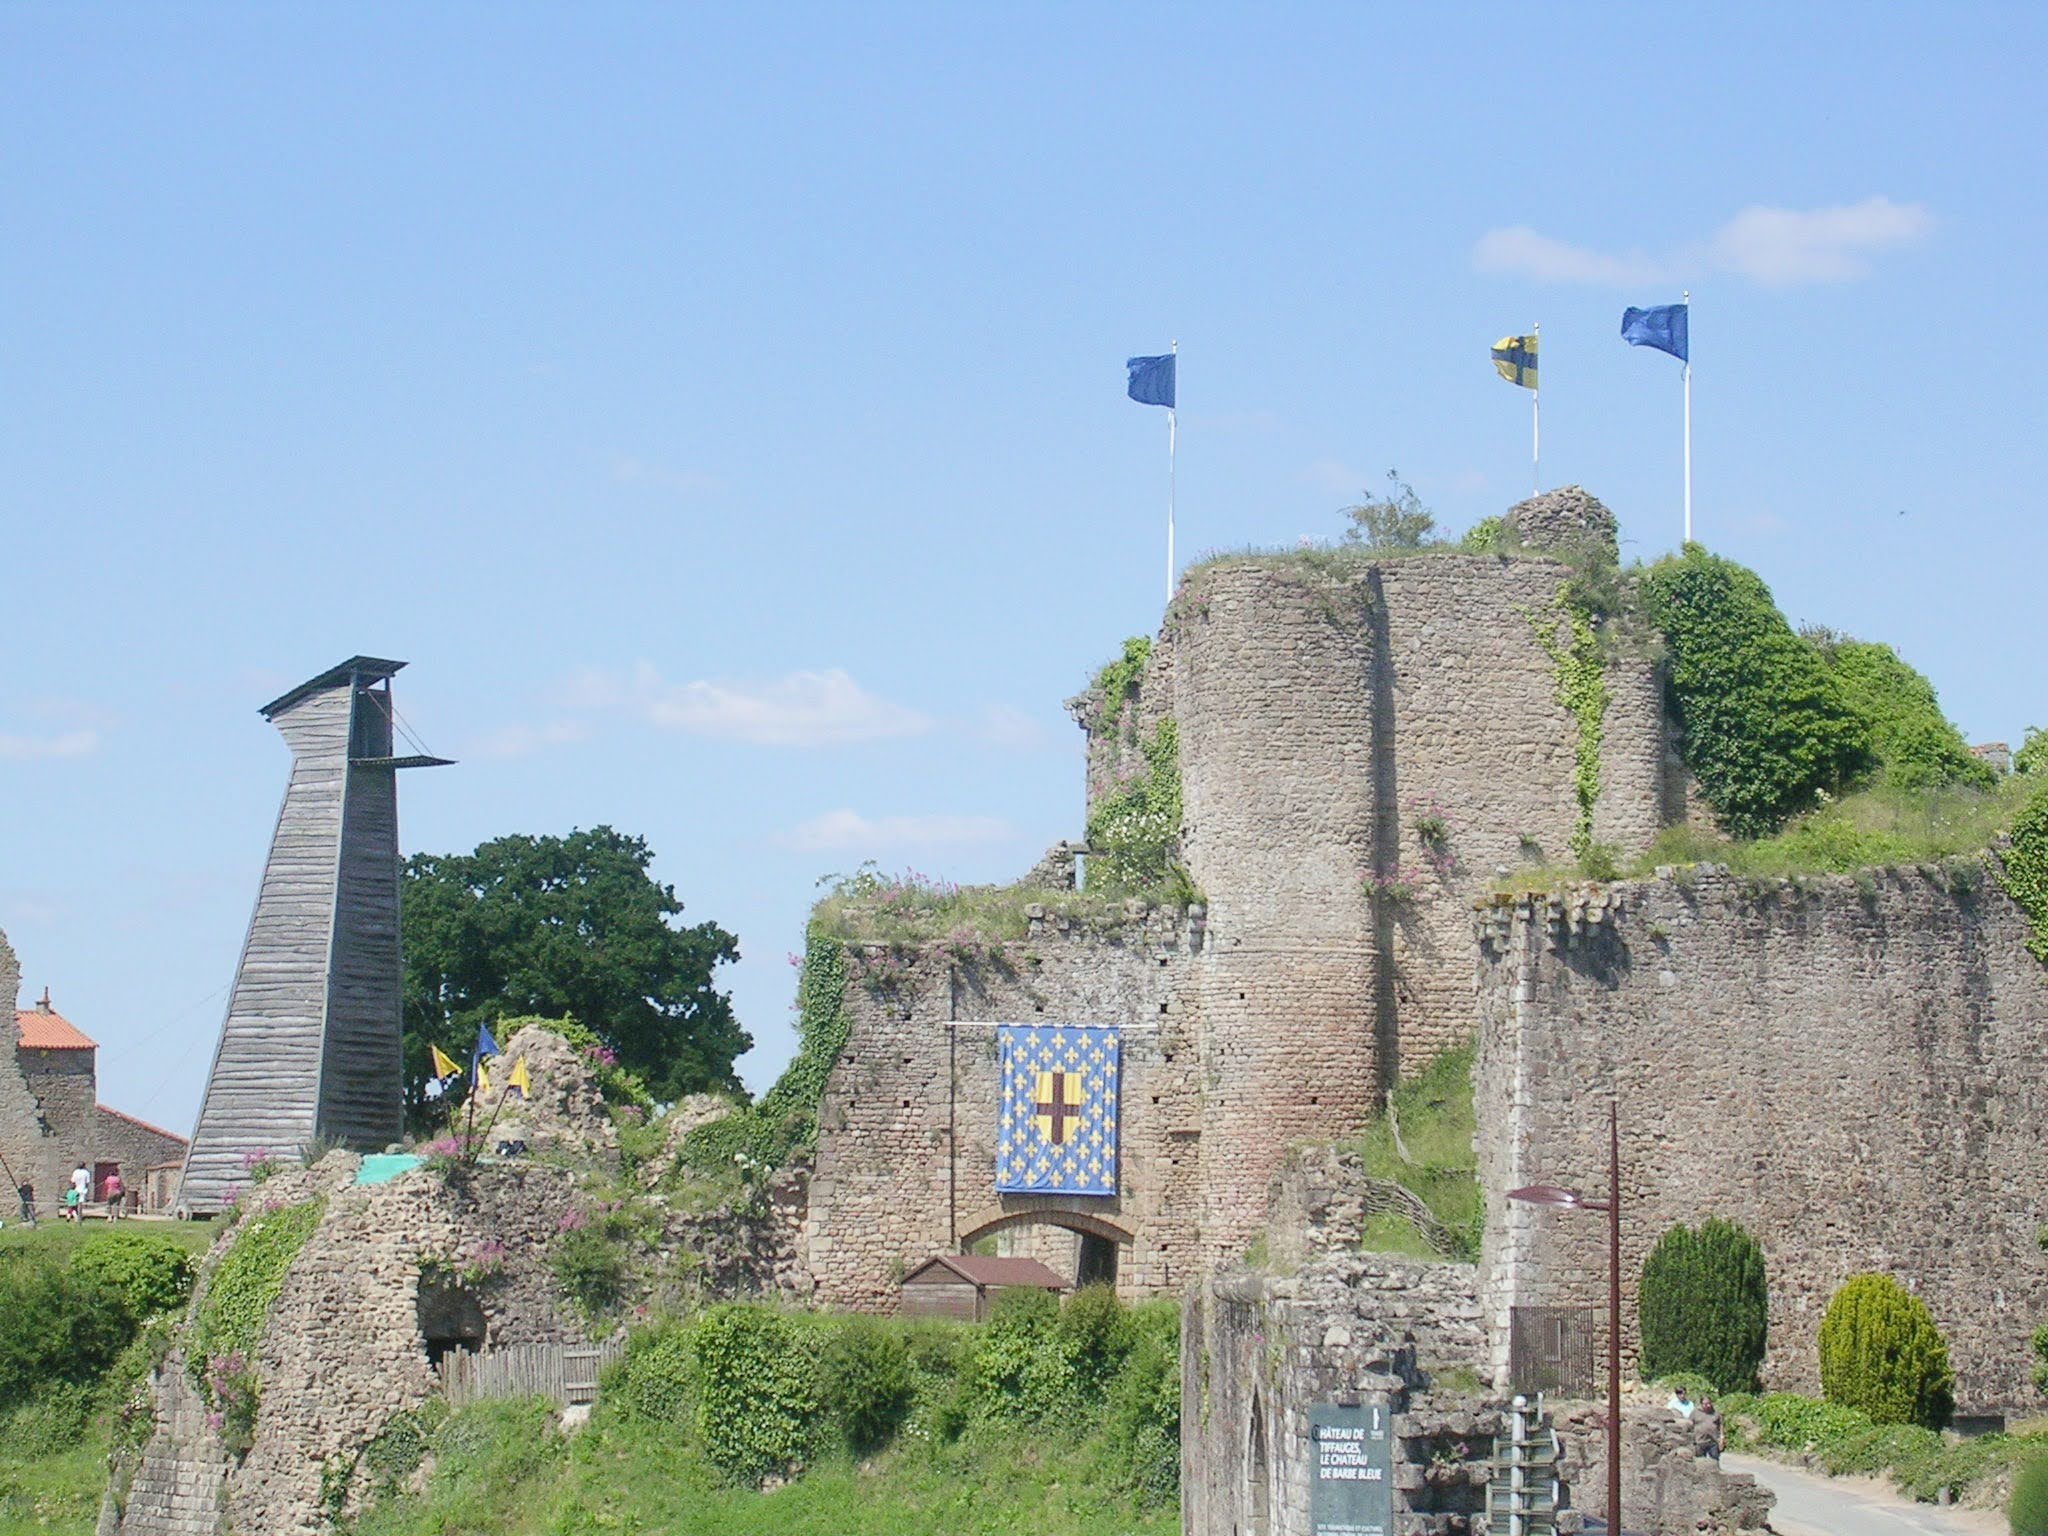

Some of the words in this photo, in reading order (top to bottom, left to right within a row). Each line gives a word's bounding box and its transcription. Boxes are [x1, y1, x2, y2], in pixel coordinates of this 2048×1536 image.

[1353, 1428, 1365, 1440] DE
[1320, 1453, 1330, 1466] LE
[1320, 1467, 1332, 1480] DE
[1333, 1467, 1357, 1480] BARBE
[1358, 1468, 1383, 1481] BLEUE
